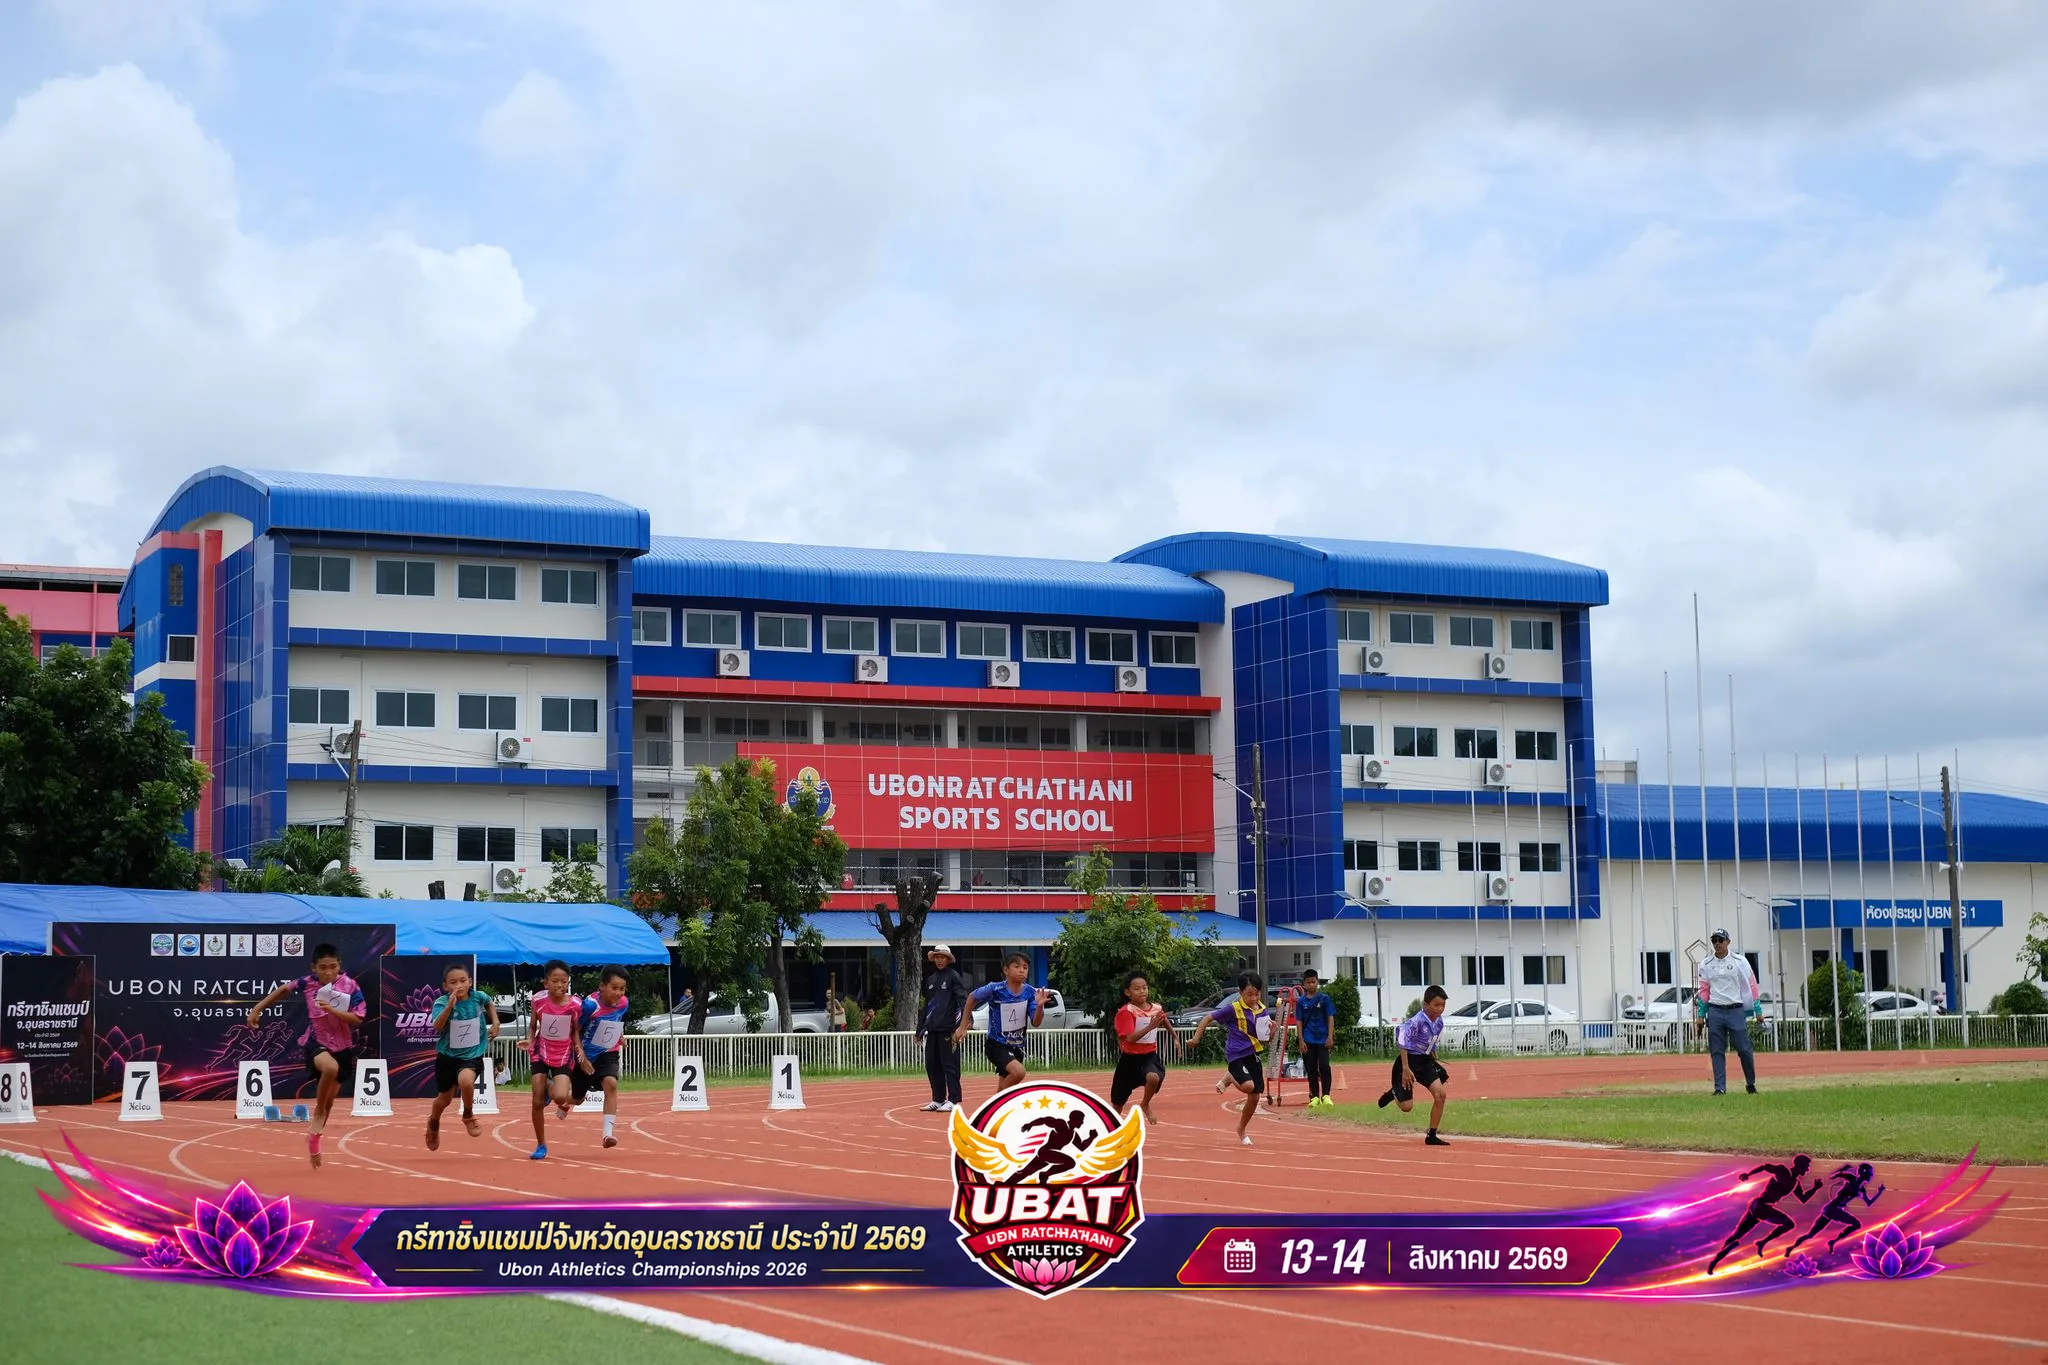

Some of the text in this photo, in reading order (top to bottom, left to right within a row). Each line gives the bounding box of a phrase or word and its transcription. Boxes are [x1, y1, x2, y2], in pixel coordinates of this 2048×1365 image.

[867, 773, 1133, 802] UBONRATCHATHANI
[900, 805, 1114, 832] SPORTS SCHOOL
[1866, 904, 1976, 924] ห้องประชุม UBNS 1
[108, 979, 182, 995] UBON
[548, 1019, 558, 1035] 6
[1008, 1008, 1018, 1024] 4
[63, 1041, 78, 1049] 2569
[458, 1024, 472, 1042] 7
[601, 1026, 615, 1044] 5
[0, 1073, 12, 1102] 8
[20, 1071, 28, 1100] 8
[131, 1071, 151, 1100] 7
[245, 1068, 264, 1097] 6
[362, 1067, 381, 1096] 5
[681, 1064, 698, 1091] 2
[780, 1063, 792, 1090] 1
